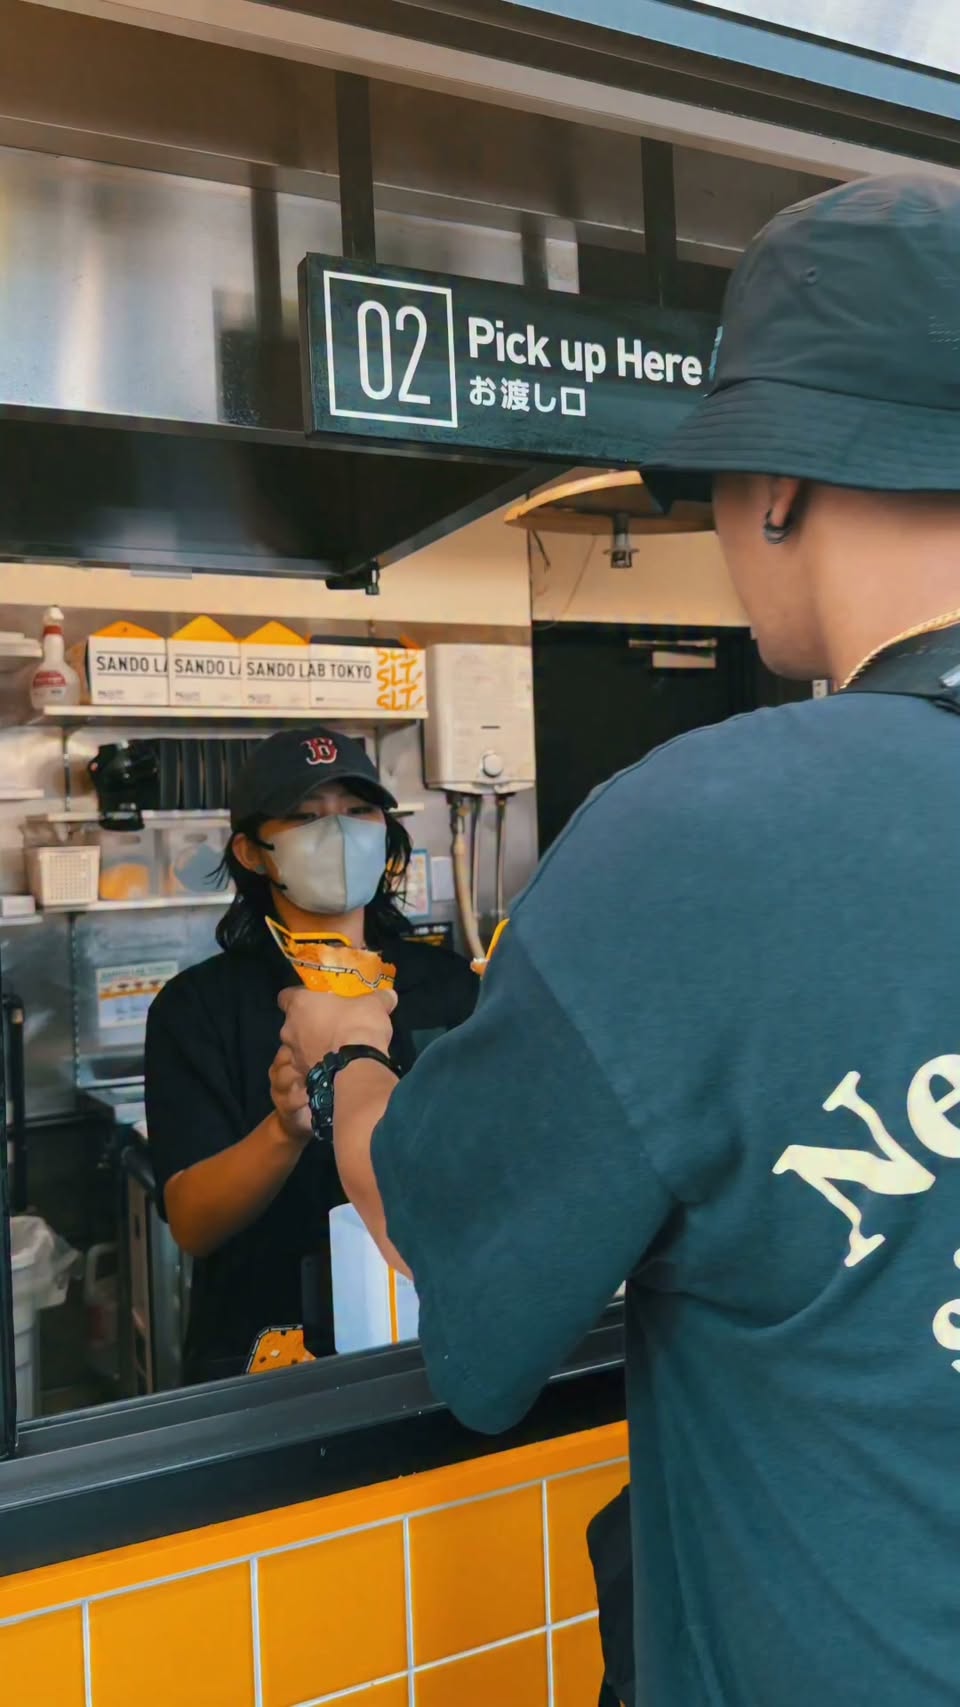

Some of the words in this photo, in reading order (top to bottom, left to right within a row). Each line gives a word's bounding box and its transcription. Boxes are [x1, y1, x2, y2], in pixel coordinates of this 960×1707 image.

[357, 300, 431, 405] 02
[468, 316, 551, 368] Pick
[560, 336, 606, 382] up
[617, 336, 702, 386] Here
[468, 375, 586, 417] お渡し口
[96, 656, 149, 672] SANDO
[174, 658, 225, 675] SANDO
[247, 662, 296, 678] SANDO
[299, 663, 326, 678] LAB
[330, 664, 372, 679] TOKYO
